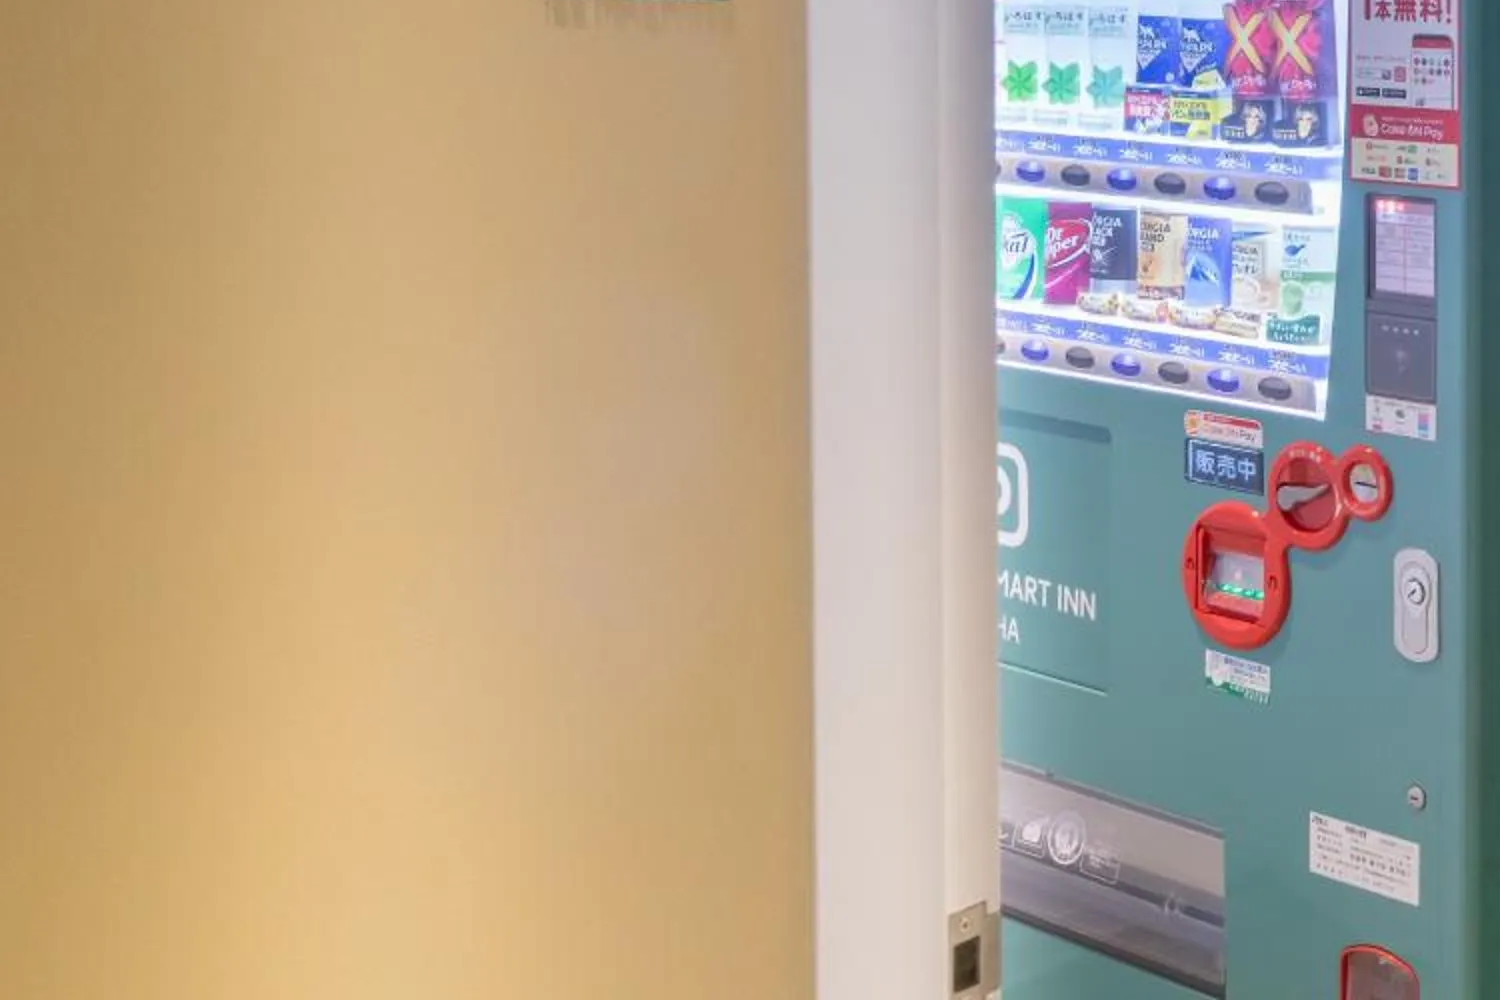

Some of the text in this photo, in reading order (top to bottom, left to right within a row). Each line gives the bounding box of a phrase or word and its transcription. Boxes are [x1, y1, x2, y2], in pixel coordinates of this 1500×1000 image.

[1196, 449, 1257, 482] 販売中
[1057, 583, 1098, 622] INN
